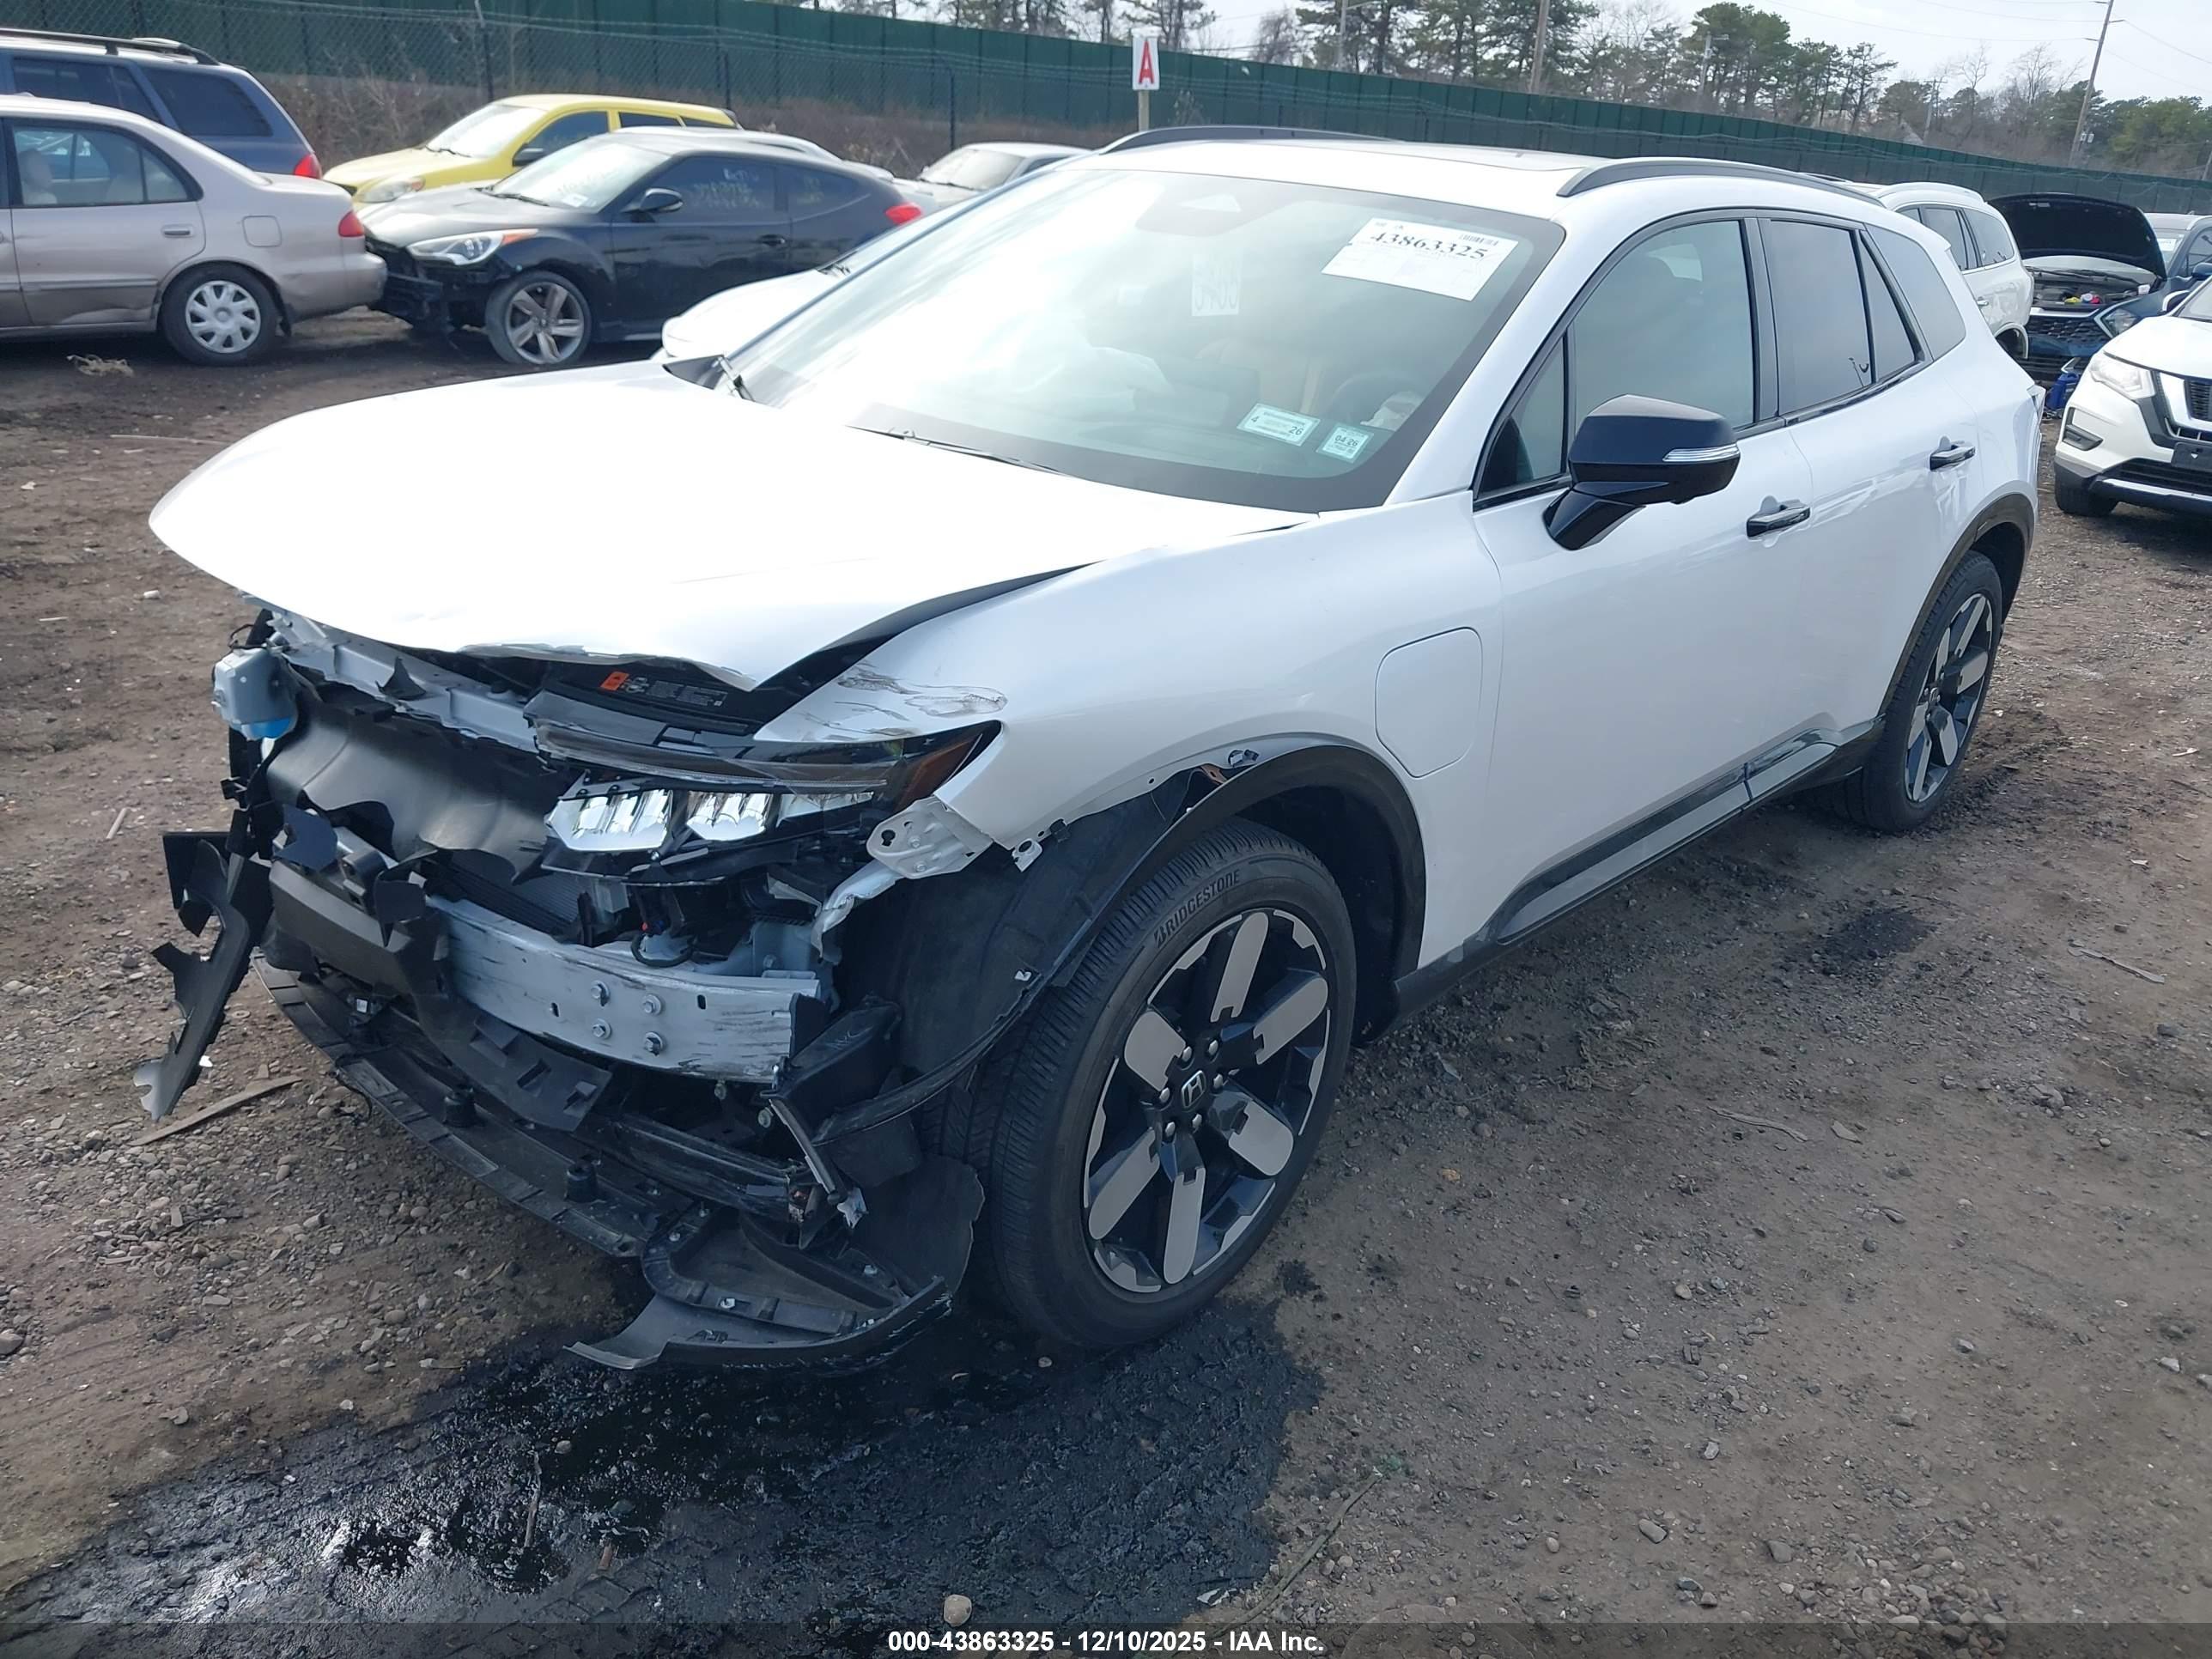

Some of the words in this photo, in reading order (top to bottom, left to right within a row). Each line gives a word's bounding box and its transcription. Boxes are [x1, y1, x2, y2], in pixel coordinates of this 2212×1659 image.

[1139, 39, 1155, 84] A
[1370, 232, 1488, 259] 43863325
[1288, 426, 1304, 435] 26
[1153, 869, 1241, 948] BRIDGESTONE
